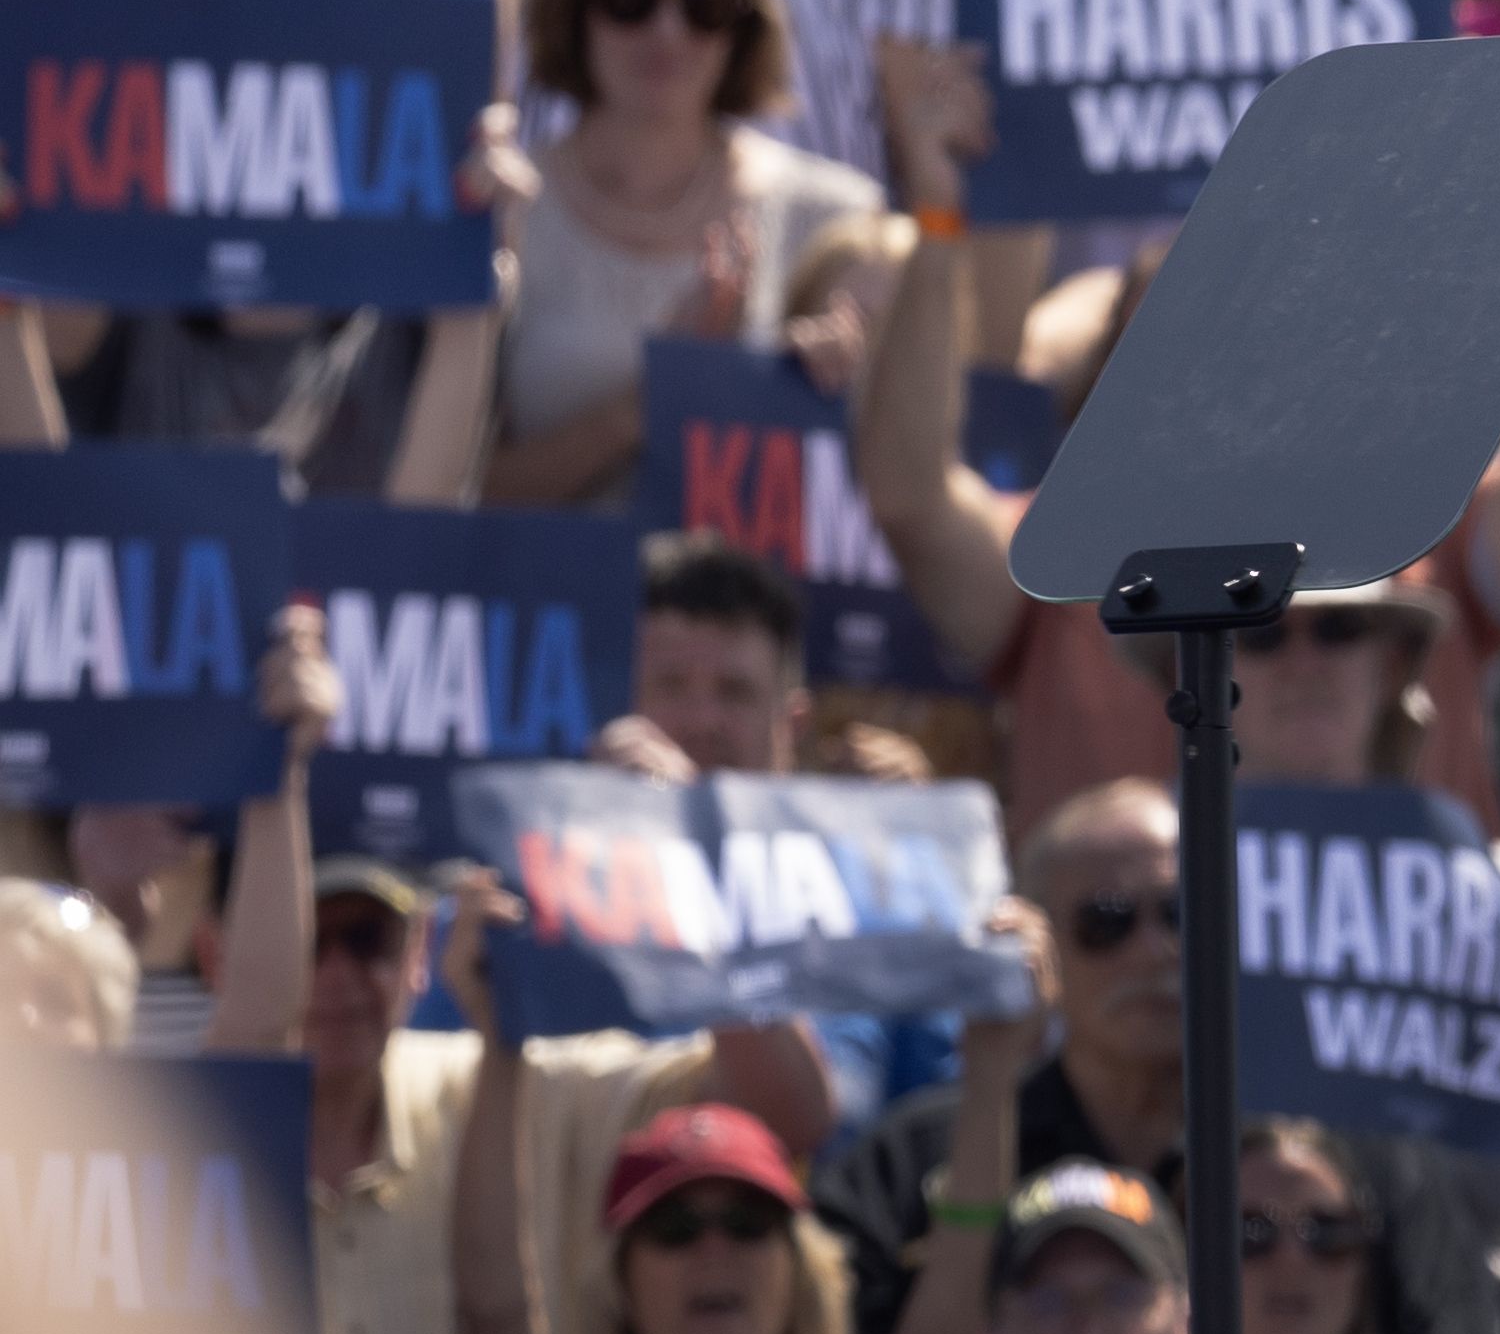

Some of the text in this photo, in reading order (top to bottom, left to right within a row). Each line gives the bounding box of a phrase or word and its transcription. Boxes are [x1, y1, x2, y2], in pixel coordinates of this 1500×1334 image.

[26, 58, 454, 223] KAMALA
[1068, 80, 1258, 175] WA
[684, 420, 902, 587] KAM
[520, 827, 966, 959] KAMALA
